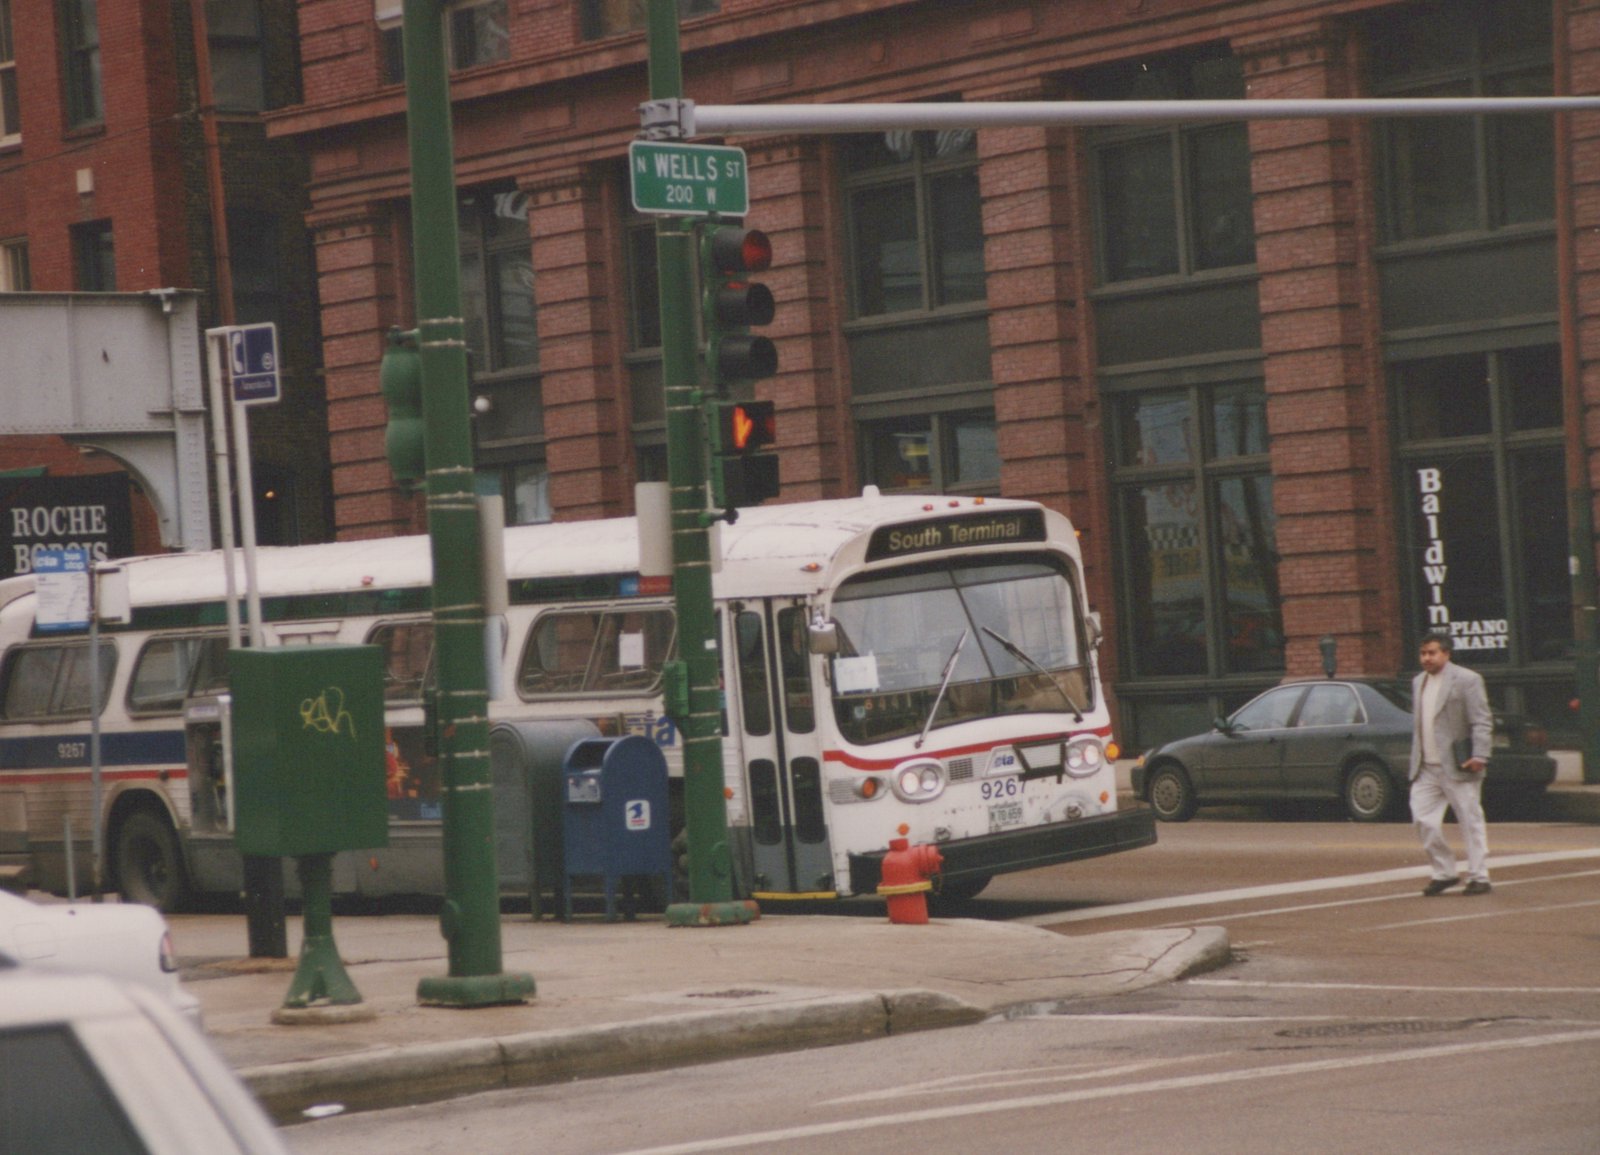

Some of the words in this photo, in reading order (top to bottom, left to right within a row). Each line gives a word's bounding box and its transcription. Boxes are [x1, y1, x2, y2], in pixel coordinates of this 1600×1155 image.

[636, 155, 647, 173] N
[653, 152, 718, 181] WELLS
[725, 161, 740, 178] ST
[666, 184, 693, 203] 200
[705, 187, 717, 205] W
[11, 505, 108, 537] ROCHE
[888, 525, 942, 551] South
[949, 518, 1021, 543] Terminal
[1417, 467, 1449, 624] Baldwin
[1450, 619, 1508, 635] PIANO
[1453, 635, 1509, 650] MART
[58, 742, 86, 759] 9267
[981, 777, 1026, 800] 9267
